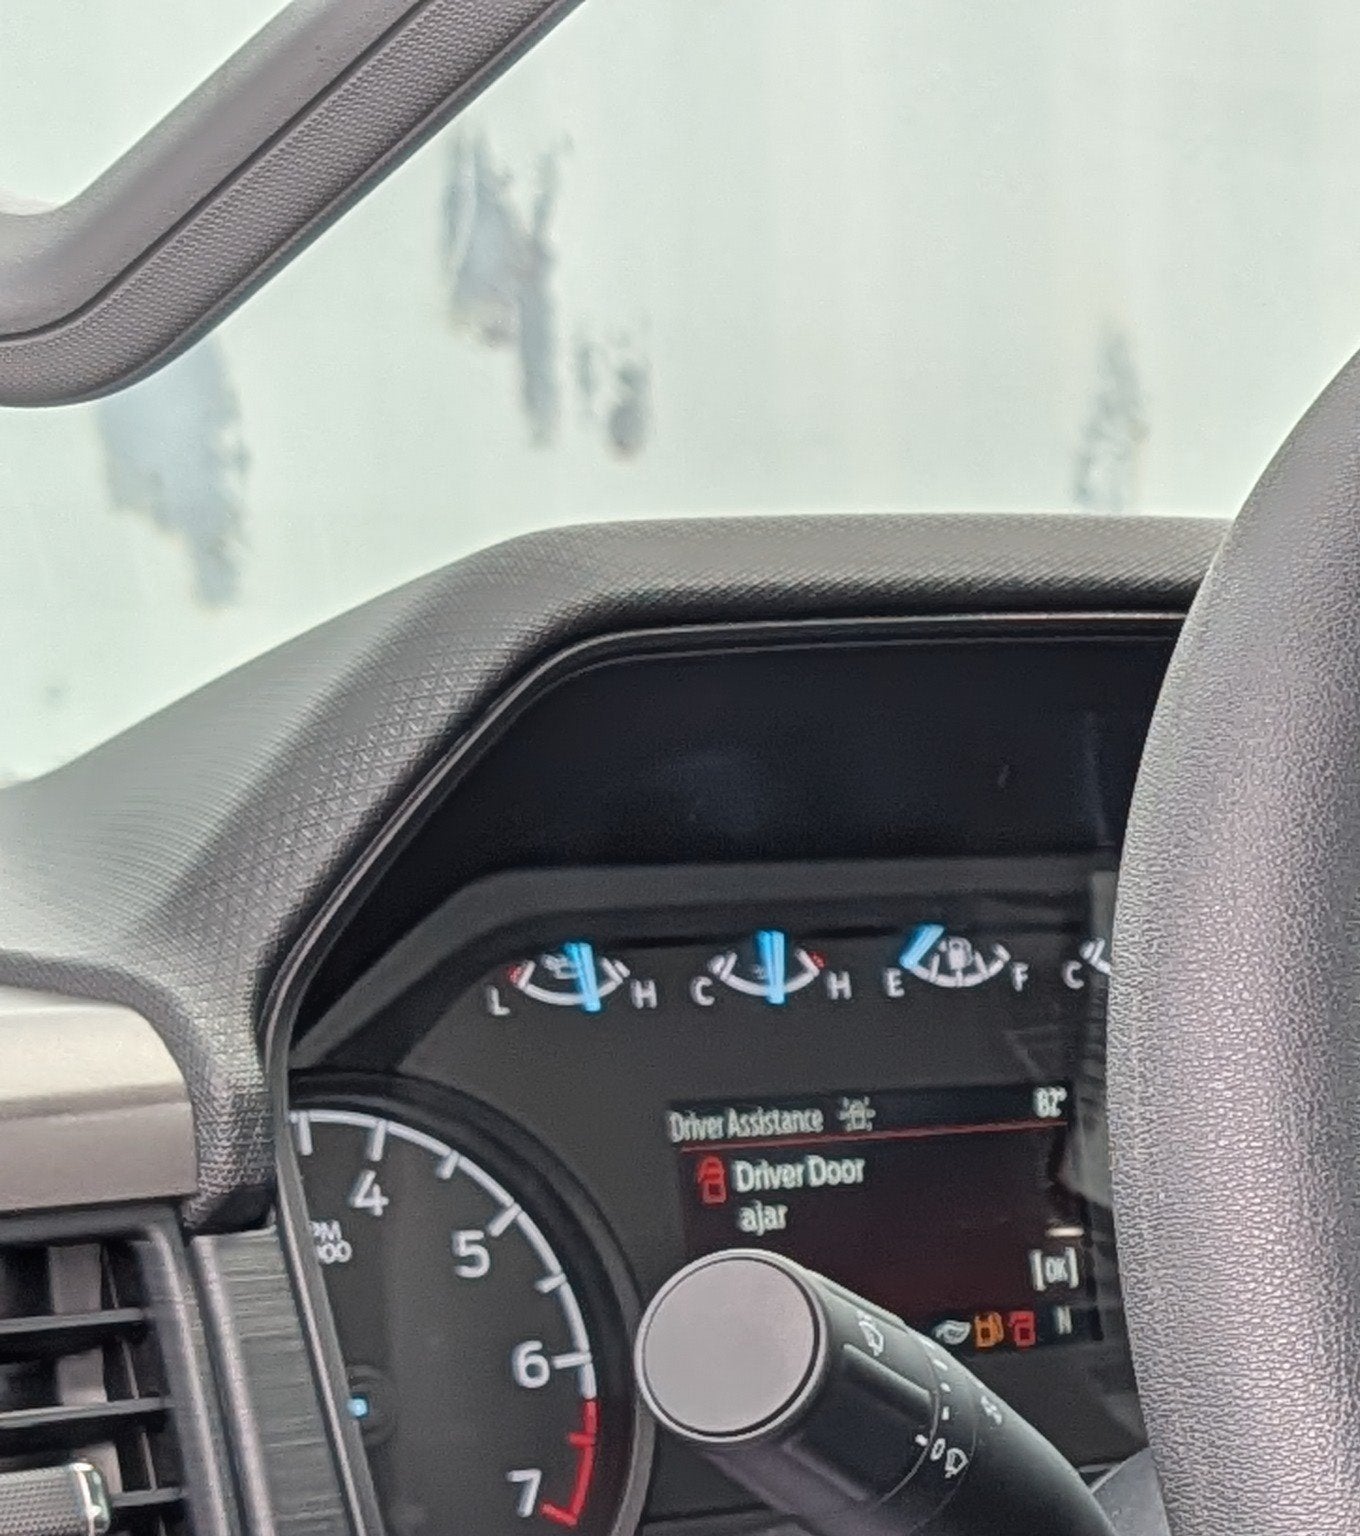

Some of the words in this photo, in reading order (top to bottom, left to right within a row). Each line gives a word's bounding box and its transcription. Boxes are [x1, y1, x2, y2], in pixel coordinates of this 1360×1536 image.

[690, 977, 715, 1006] C
[827, 971, 851, 999] H
[884, 967, 905, 998] E
[1011, 962, 1030, 992] F
[1062, 960, 1085, 990] C
[631, 980, 657, 1009] H
[667, 1111, 726, 1144] Driver
[727, 1107, 824, 1138] Assistance
[732, 1158, 805, 1194] Driver
[806, 1154, 866, 1188] Door
[349, 1170, 389, 1217] 4
[736, 1199, 789, 1236] ajar
[451, 1230, 491, 1278] 5
[511, 1340, 551, 1389] 6
[507, 1468, 542, 1517] 7
